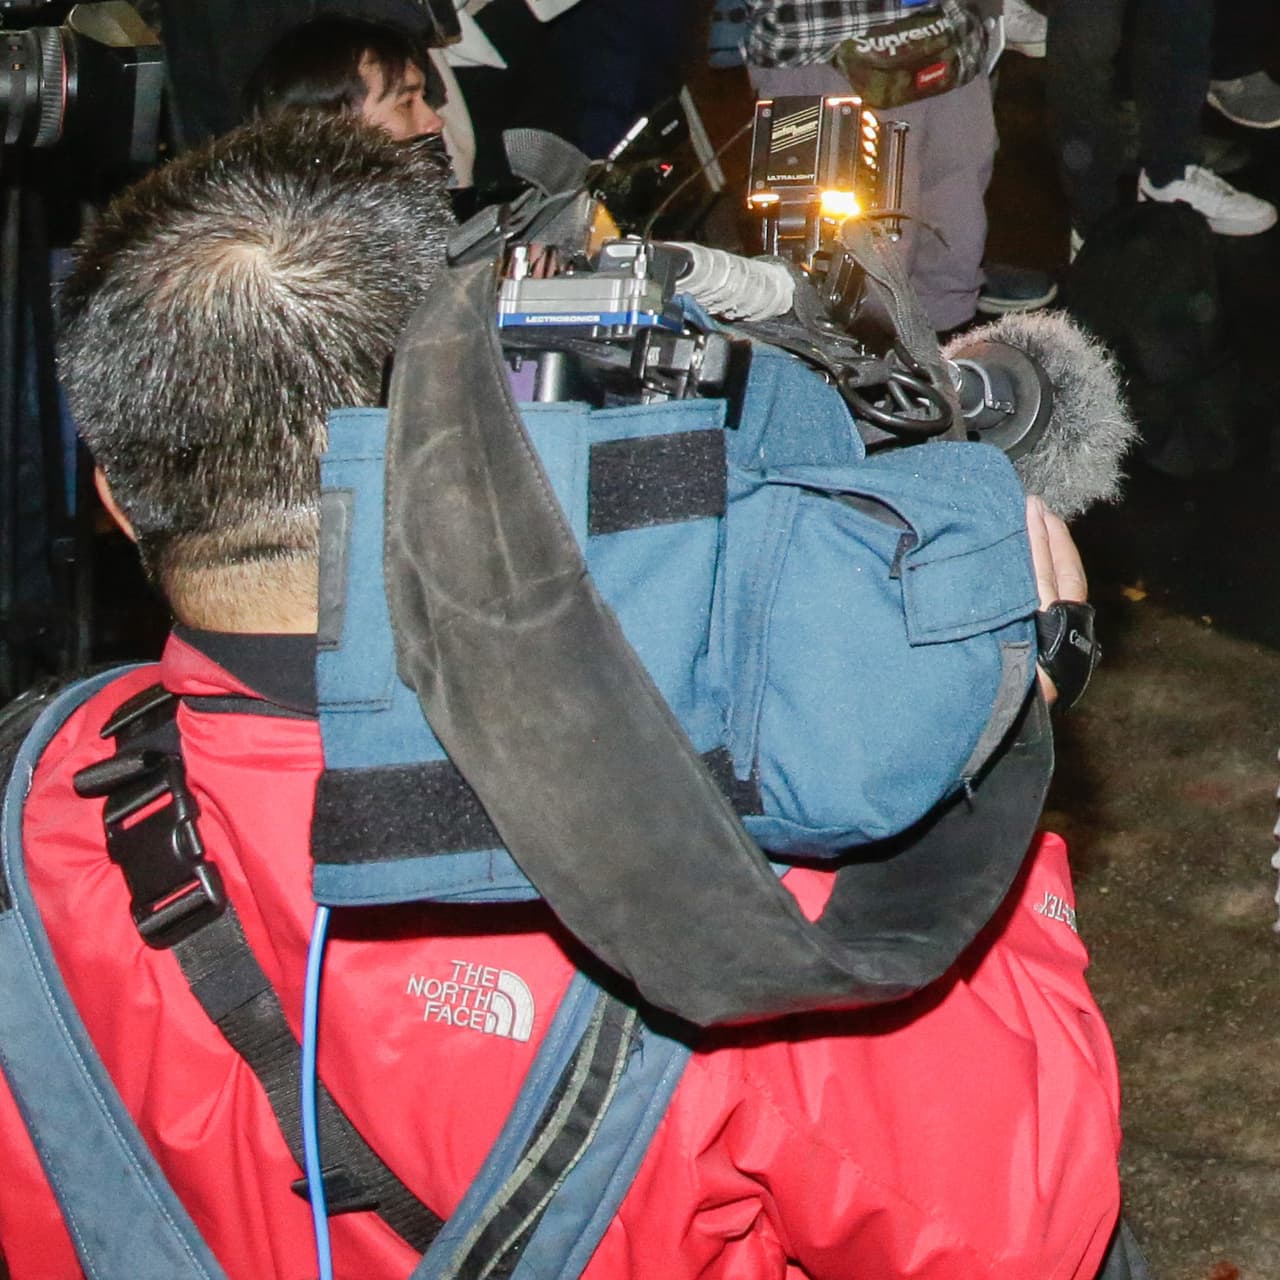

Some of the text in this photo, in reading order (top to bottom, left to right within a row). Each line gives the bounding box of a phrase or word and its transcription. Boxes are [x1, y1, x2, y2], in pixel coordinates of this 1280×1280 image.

[450, 959, 499, 989] THE
[406, 973, 493, 1011] NORTH
[423, 1000, 486, 1031] FACE
